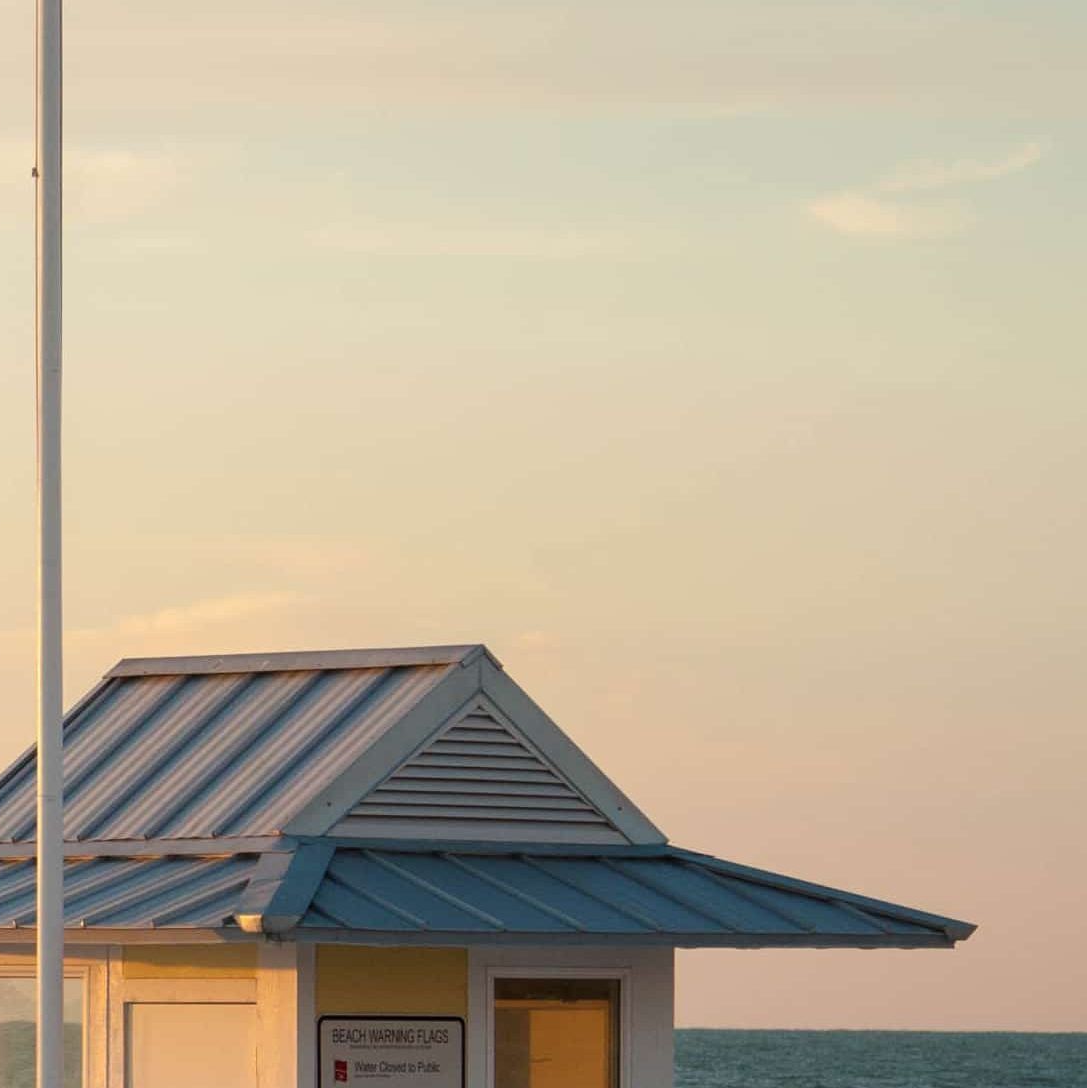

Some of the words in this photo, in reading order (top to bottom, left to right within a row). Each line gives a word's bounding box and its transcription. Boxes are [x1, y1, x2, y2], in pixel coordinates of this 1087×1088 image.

[332, 1029, 366, 1043] BEACH
[368, 1029, 415, 1043] WARNING
[417, 1029, 449, 1044] FLAGS
[354, 1061, 377, 1072] Water
[379, 1061, 407, 1072] Closed
[408, 1062, 416, 1072] to
[417, 1061, 440, 1073] Public
